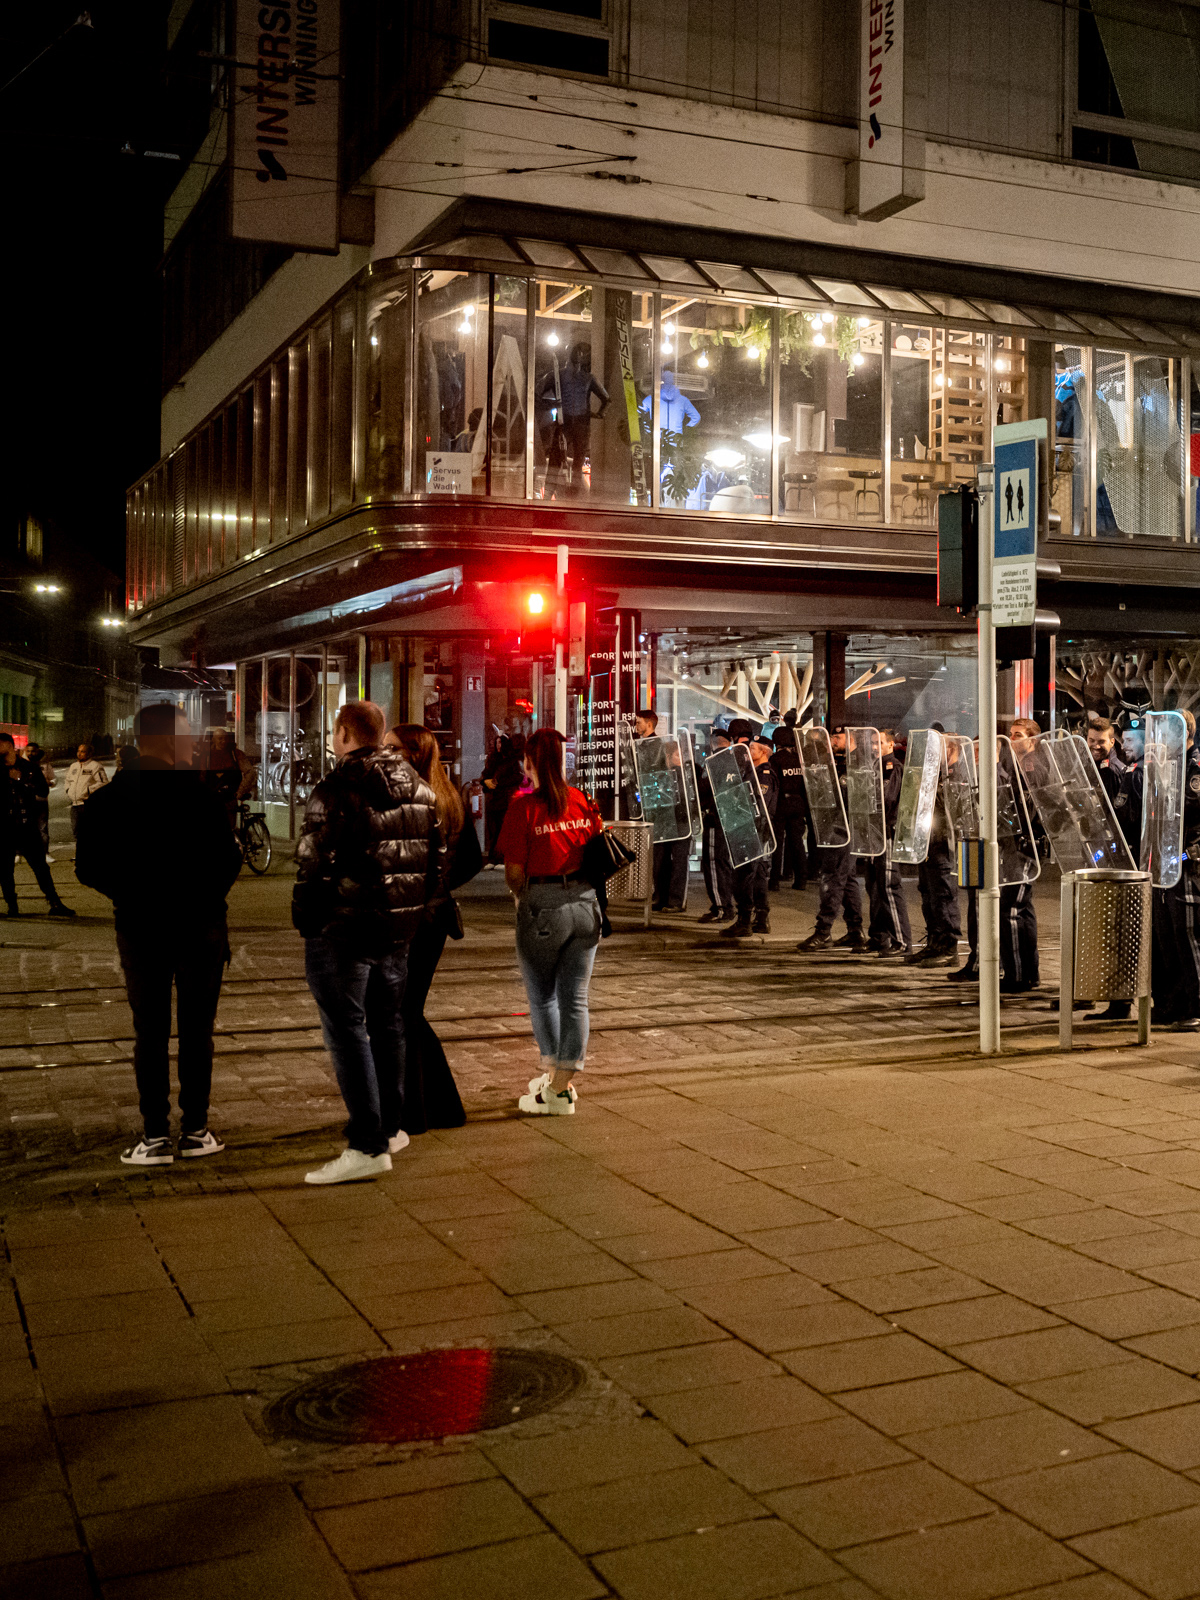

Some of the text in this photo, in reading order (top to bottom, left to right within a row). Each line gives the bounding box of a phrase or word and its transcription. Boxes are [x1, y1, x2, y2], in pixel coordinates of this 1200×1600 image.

[615, 297, 631, 372] FISCHER
[433, 466, 461, 475] Servus
[580, 753, 614, 764] SERVICE
[584, 780, 609, 790] MEHR
